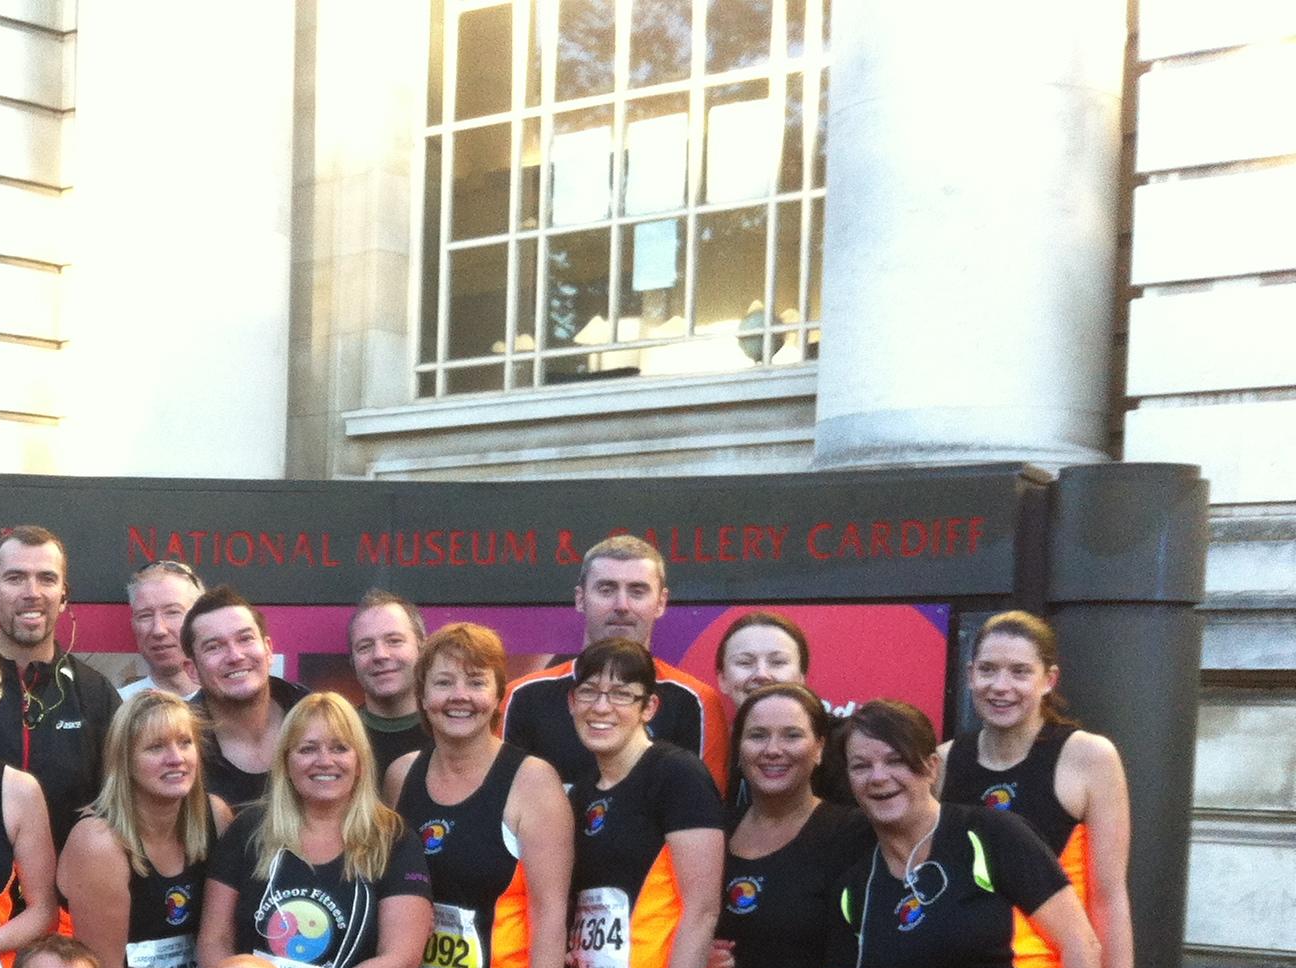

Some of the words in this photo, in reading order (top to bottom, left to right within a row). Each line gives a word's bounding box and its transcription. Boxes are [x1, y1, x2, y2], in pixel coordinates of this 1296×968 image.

[127, 526, 342, 567] NATIONAL
[357, 529, 538, 567] MUSEUM
[554, 528, 583, 565] &
[607, 524, 790, 565] ALLERY
[807, 516, 987, 561] CARDIFF
[254, 887, 309, 922] Outdoor
[309, 887, 347, 931] Fitness
